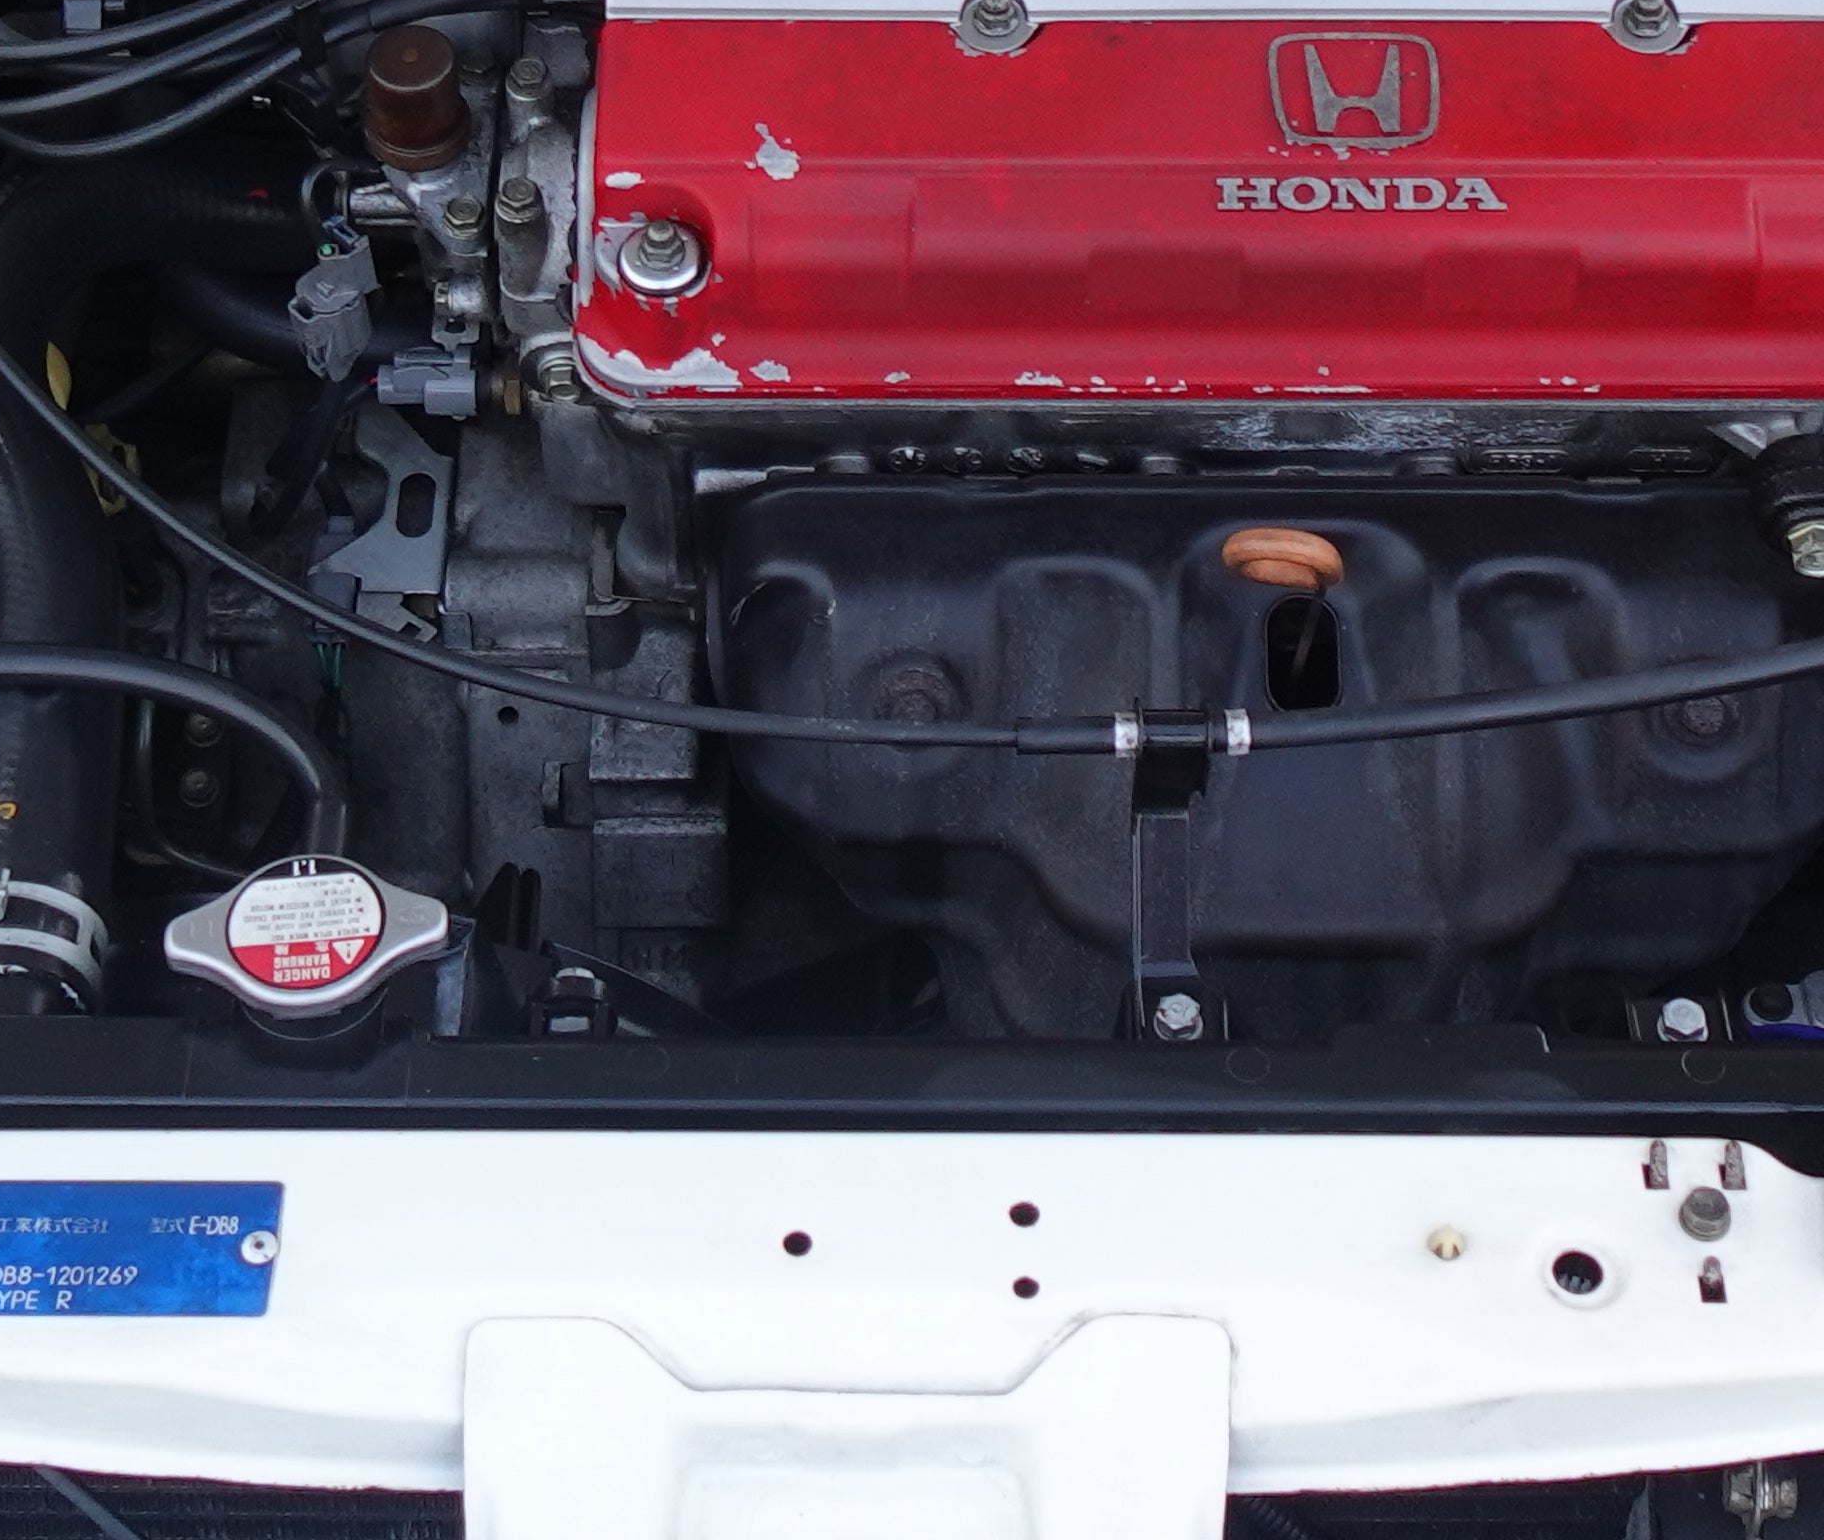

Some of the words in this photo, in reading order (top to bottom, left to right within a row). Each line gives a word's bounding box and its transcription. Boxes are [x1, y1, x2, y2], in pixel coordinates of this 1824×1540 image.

[1216, 176, 1508, 211] HONDA
[274, 966, 330, 983] DANGER
[188, 1214, 240, 1236] E-DB8
[55, 1289, 73, 1310] R
